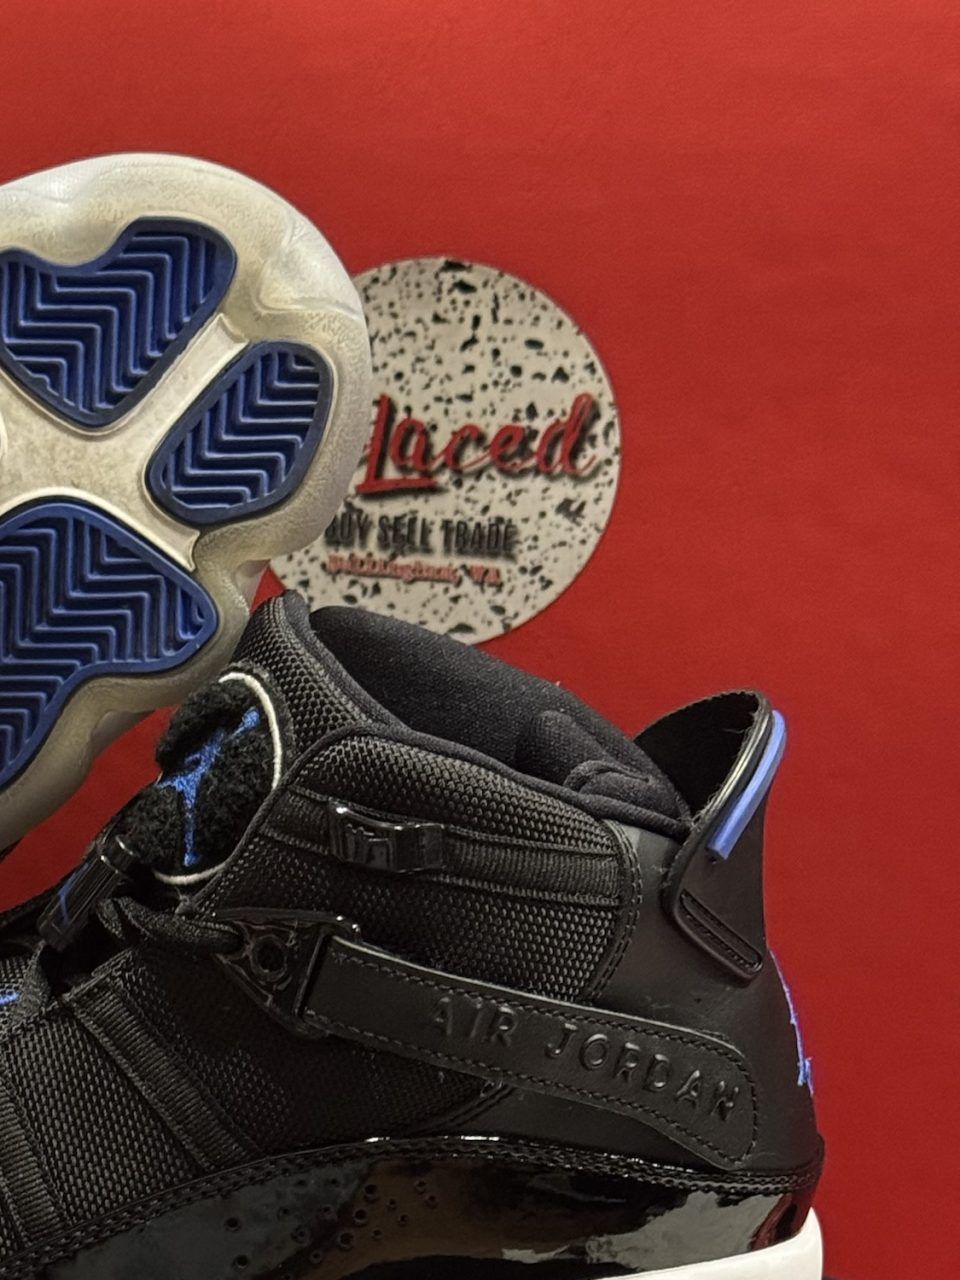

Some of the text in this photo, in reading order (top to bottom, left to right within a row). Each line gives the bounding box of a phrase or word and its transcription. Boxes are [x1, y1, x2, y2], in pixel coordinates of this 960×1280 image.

[355, 392, 597, 497] Laced
[324, 511, 519, 562] BUY SELL TRADE
[434, 997, 741, 1124] AIR JORDAN
